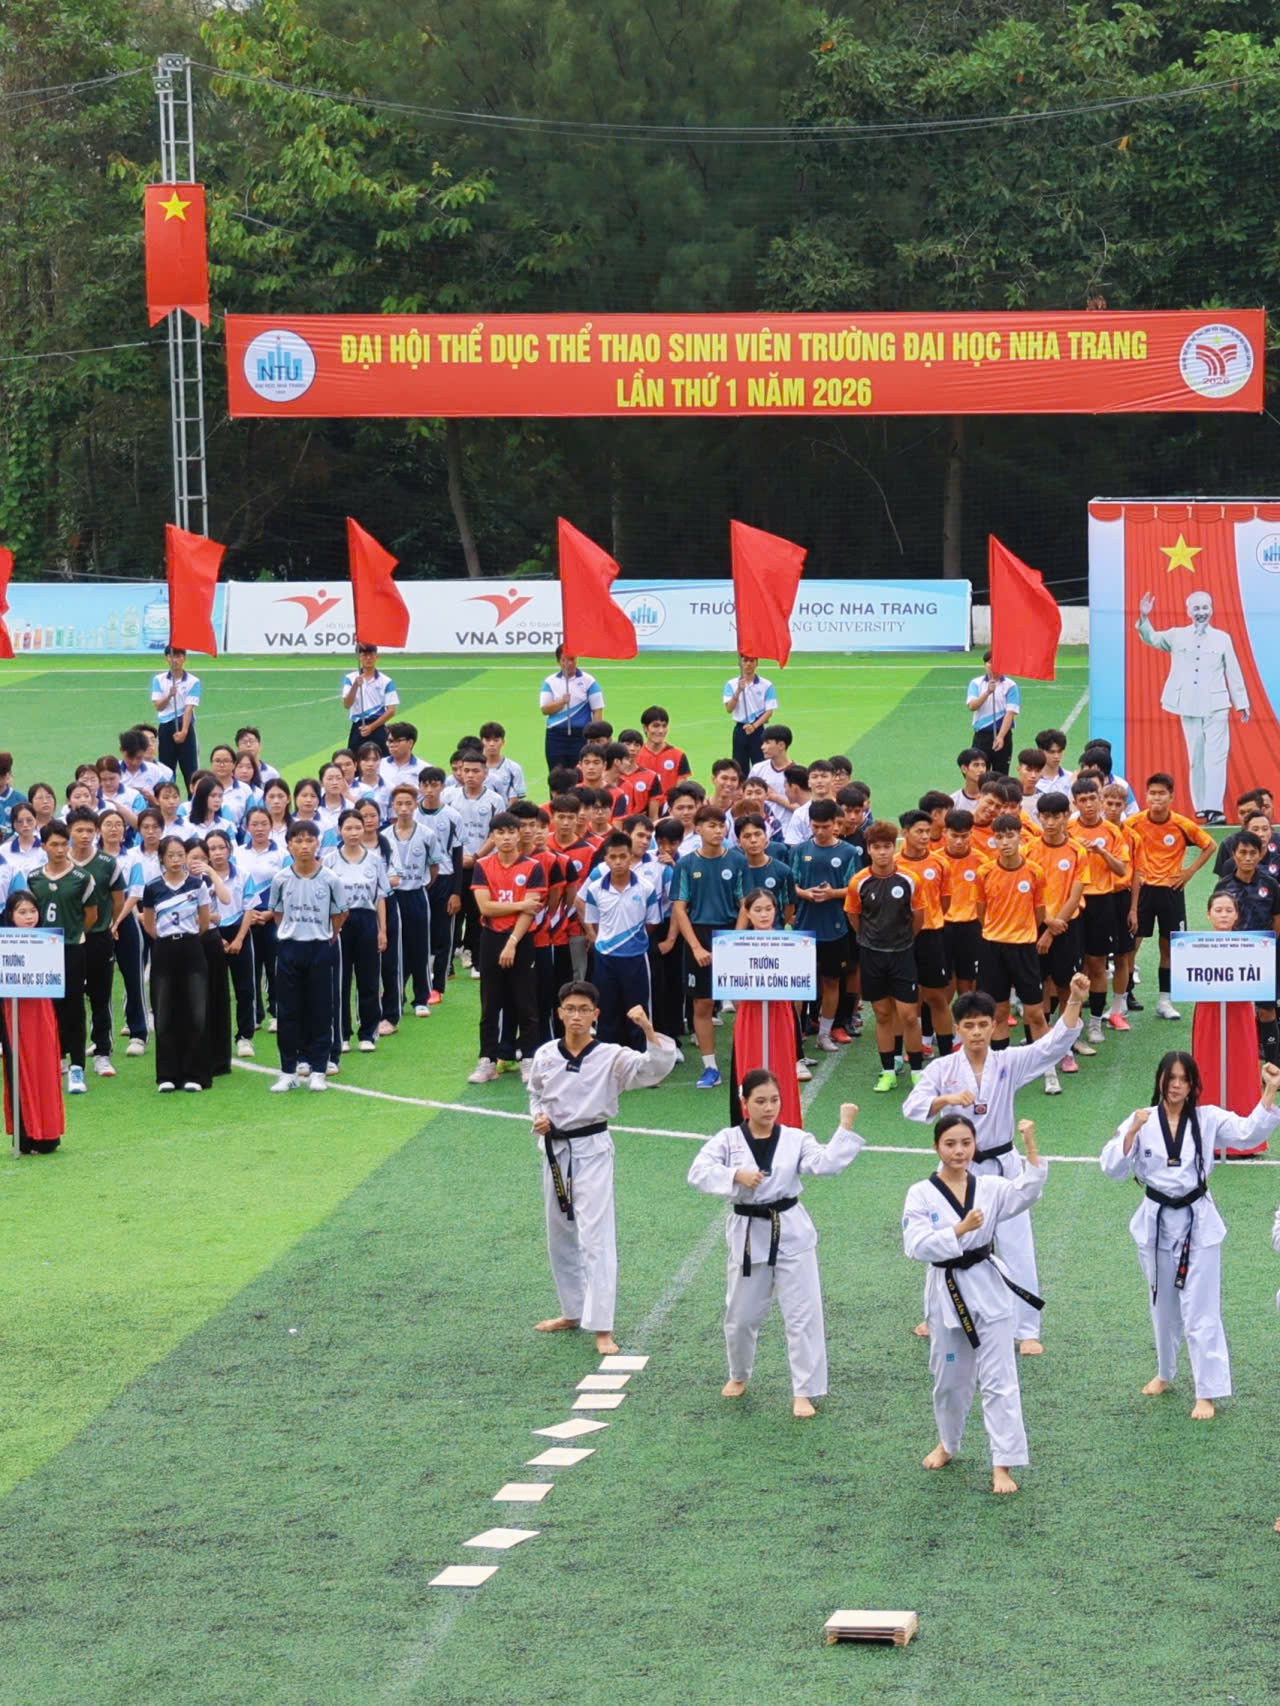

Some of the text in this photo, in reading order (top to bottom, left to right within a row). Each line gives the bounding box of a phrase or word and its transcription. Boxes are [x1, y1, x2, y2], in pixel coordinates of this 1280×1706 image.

[341, 334, 381, 370] ĐẠI
[390, 328, 430, 369] HỘI
[438, 322, 485, 362] THỂ
[491, 334, 539, 369] DỤC
[547, 322, 593, 362] THỂ
[598, 333, 660, 362] THAO
[669, 333, 727, 362] SINH
[735, 326, 791, 361] VIÊN
[798, 326, 895, 361] TRƯỜNG
[903, 332, 944, 367] ĐẠI
[953, 332, 1001, 367] HỌC
[1010, 332, 1060, 360] NHA
[1068, 331, 1147, 360] TRANG
[261, 365, 298, 381] NTU
[617, 369, 872, 407] LẦN THỨ 1 NĂM 2026
[689, 599, 938, 617] TRƯỜ HỌC NHA TRANG
[818, 620, 906, 633] UNIVERSITY
[264, 632, 308, 647] VNA
[455, 631, 499, 645] VNA
[46, 902, 57, 922] 6
[1186, 963, 1261, 986] TRỌNG TÀI
